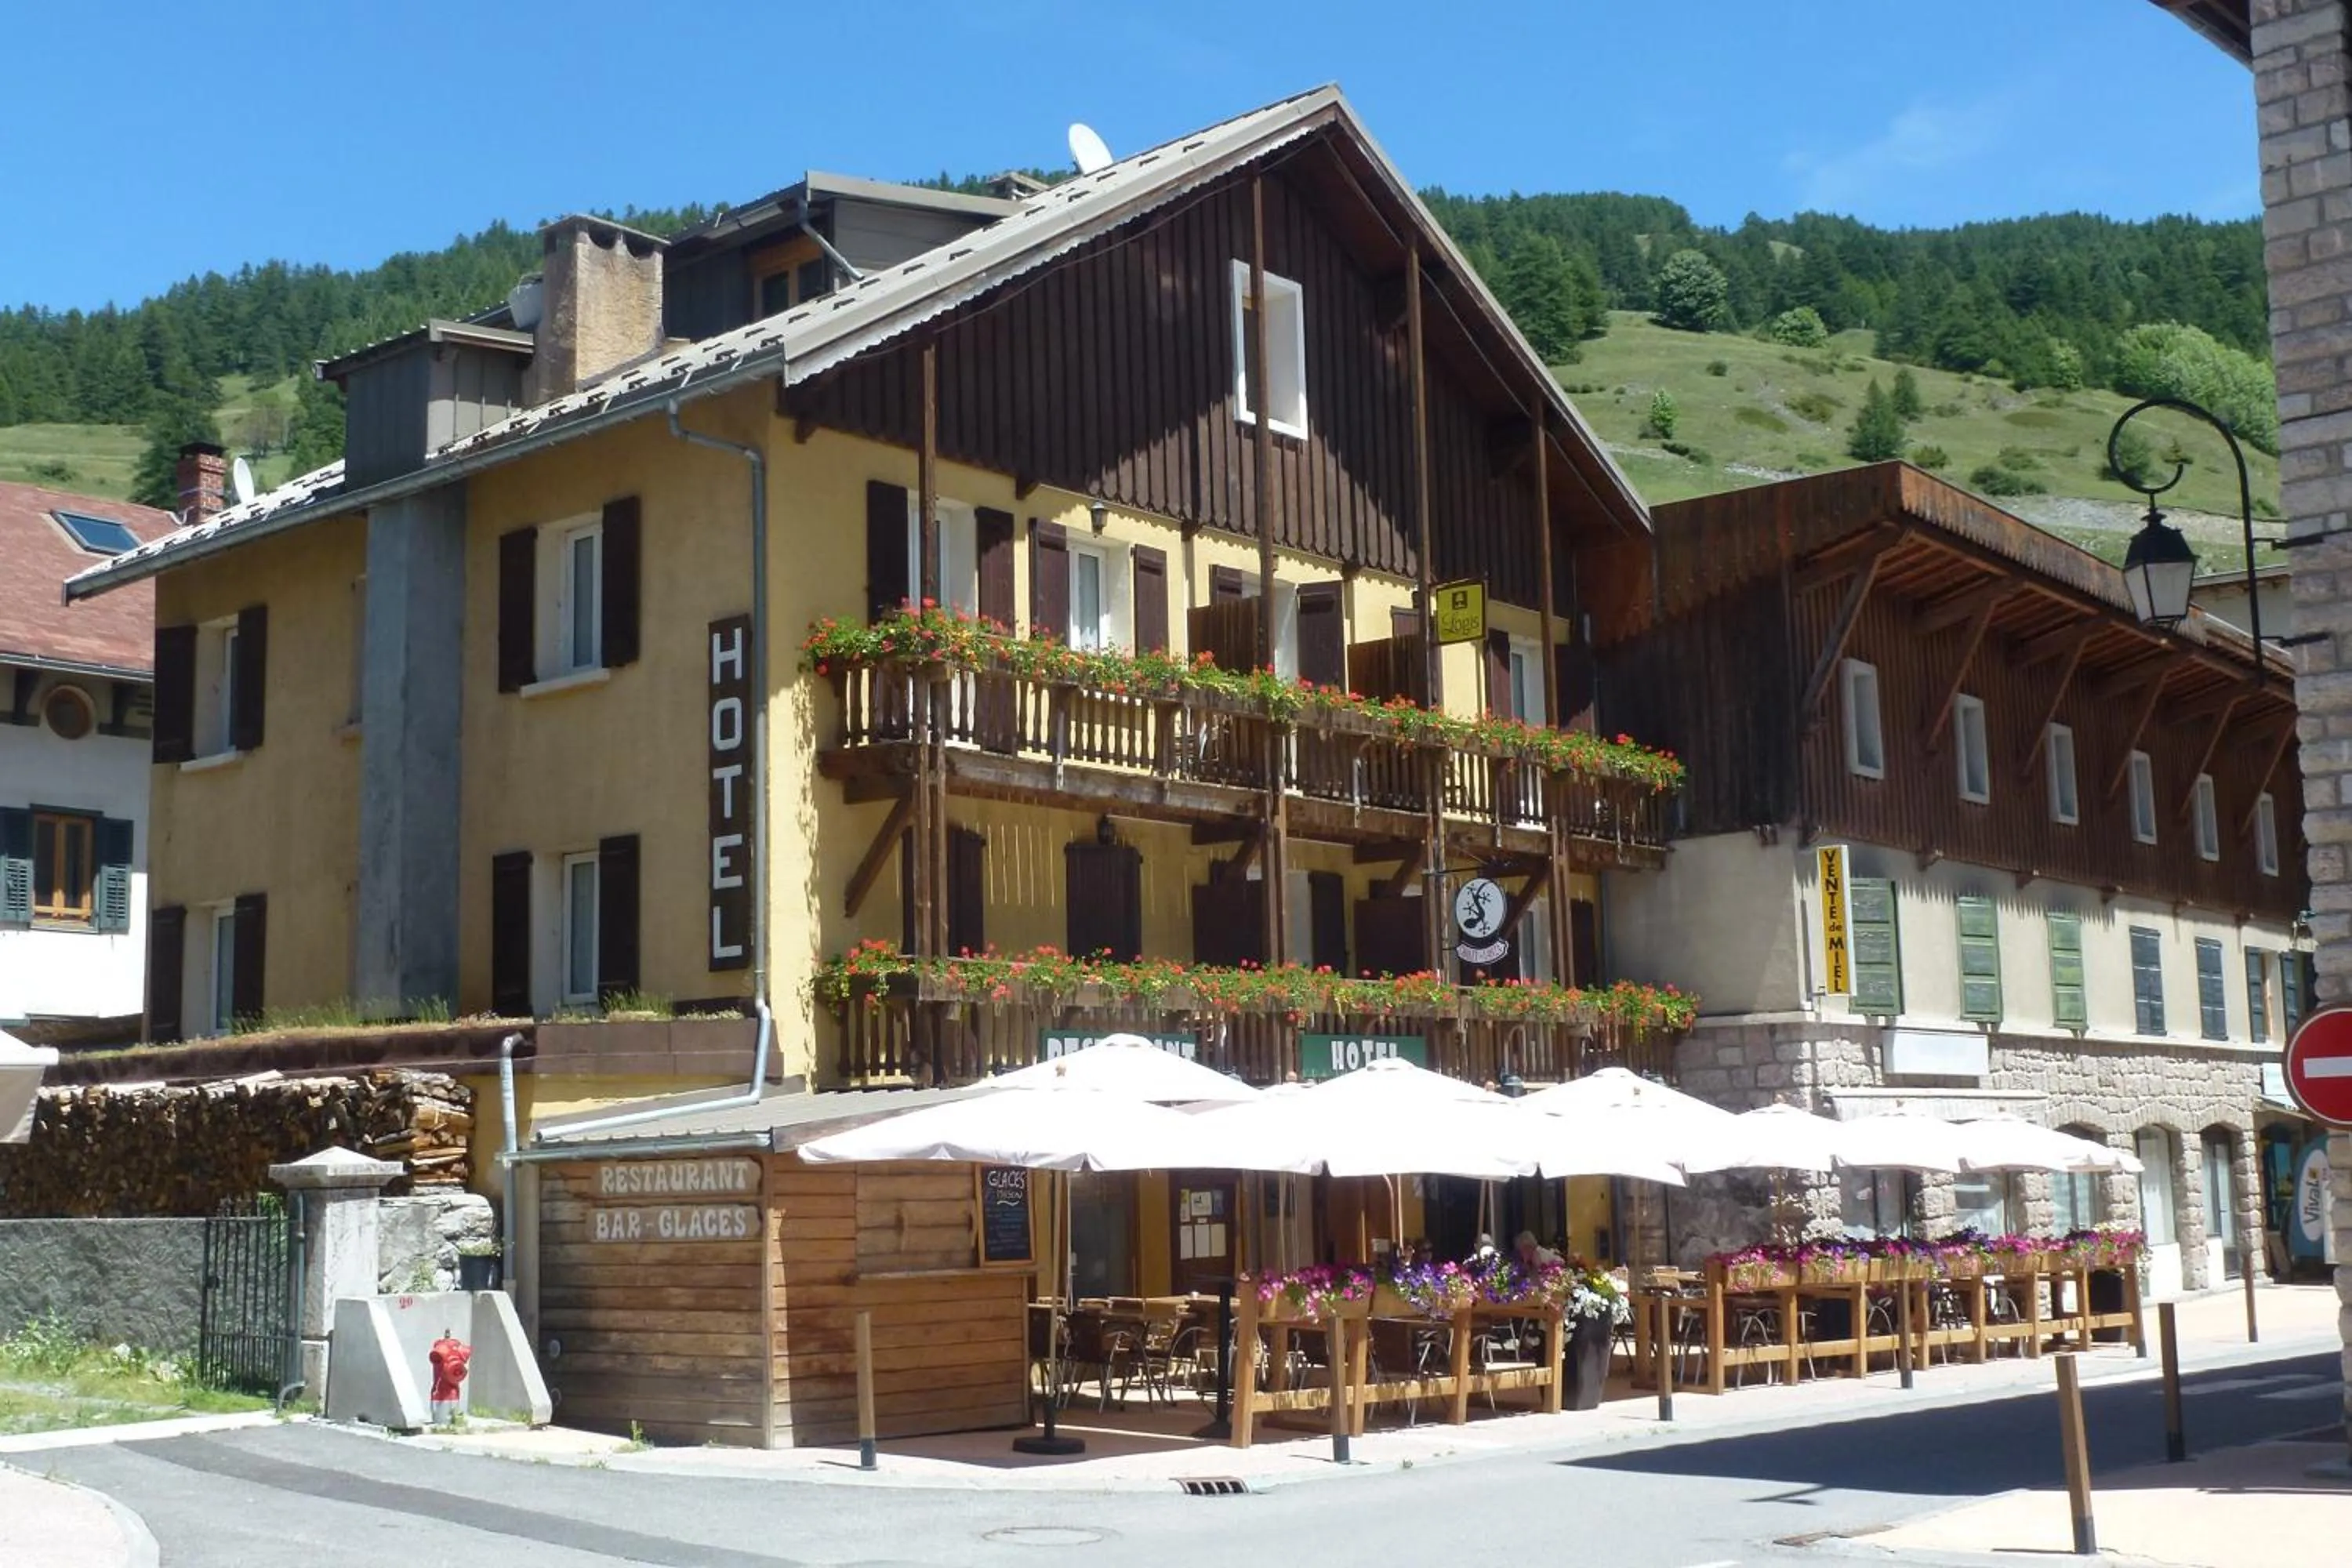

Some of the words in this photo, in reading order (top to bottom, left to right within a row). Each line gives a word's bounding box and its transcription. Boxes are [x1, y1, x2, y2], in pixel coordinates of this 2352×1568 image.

[712, 626, 743, 959] HOTEL
[1824, 850, 1839, 919] VENTE
[1828, 921, 1842, 932] de
[1828, 937, 1844, 992] MIEL
[601, 1161, 749, 1194] RESTAURANT
[596, 1210, 641, 1240] BAR
[658, 1207, 746, 1238] GLACES
